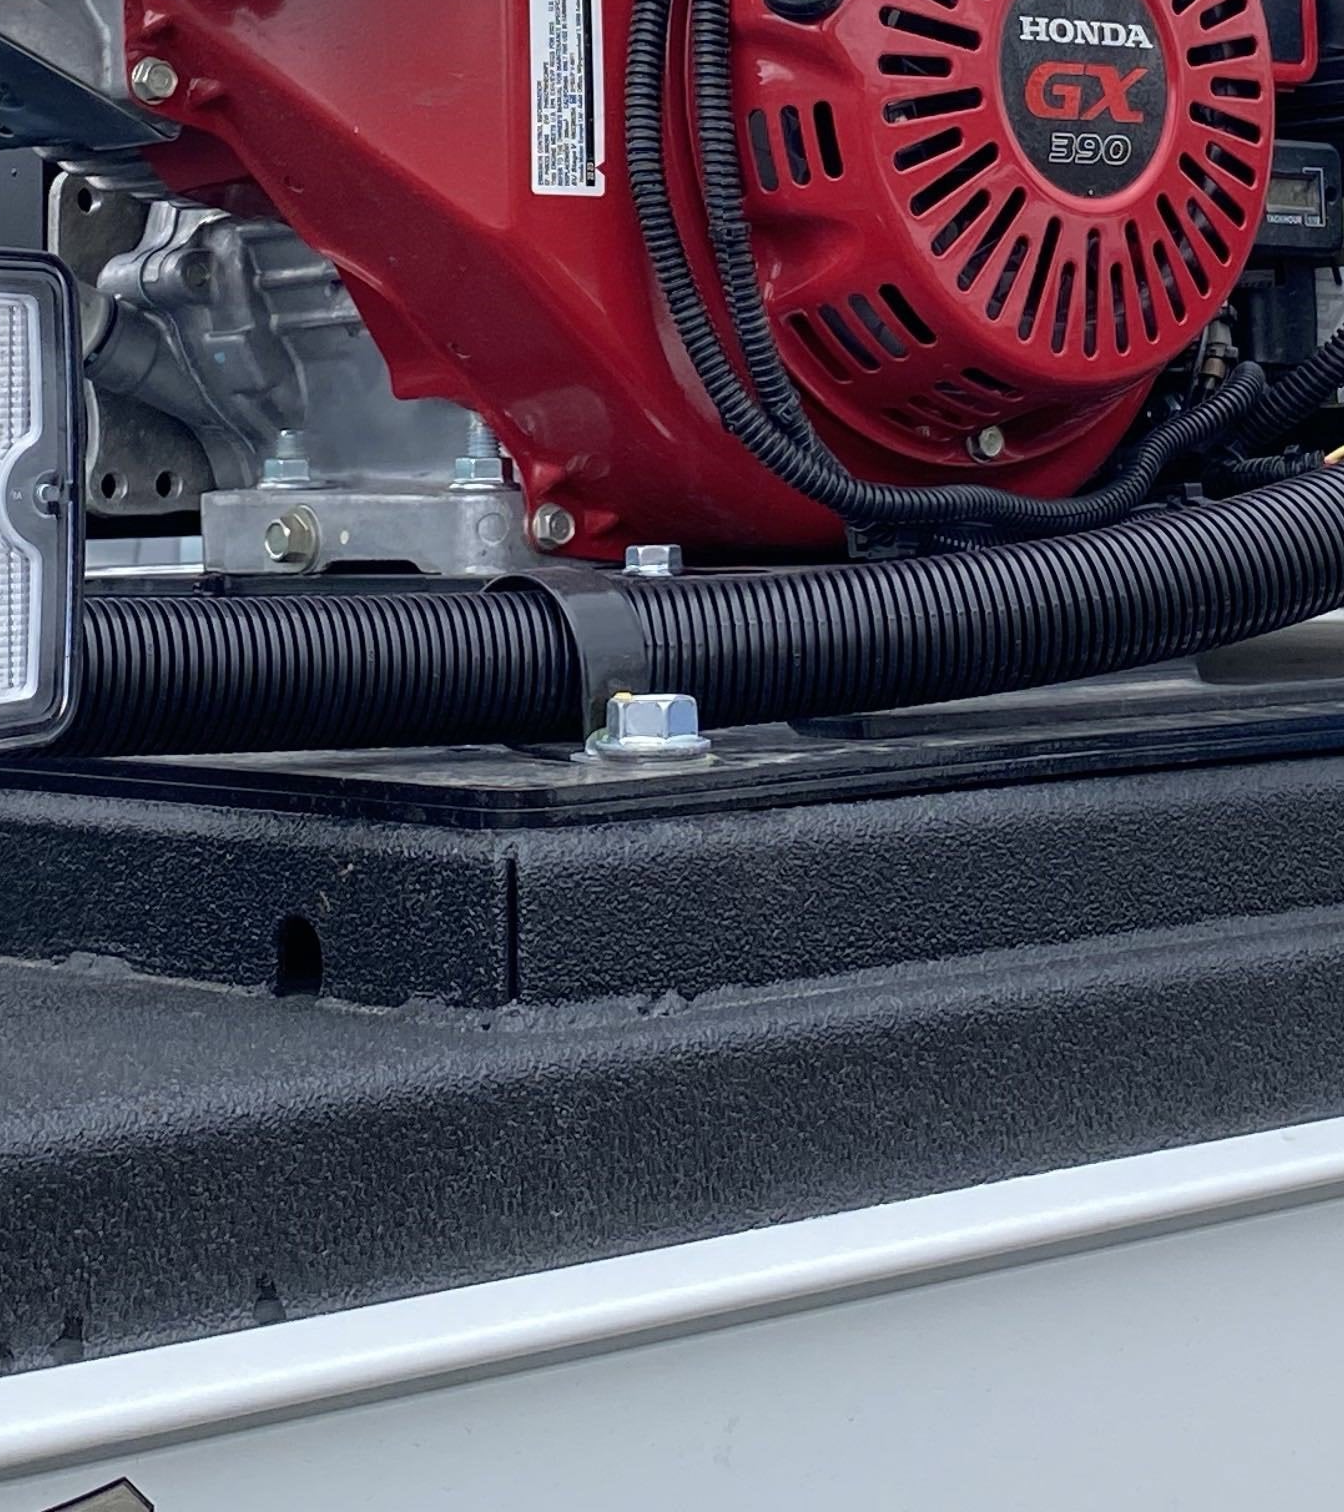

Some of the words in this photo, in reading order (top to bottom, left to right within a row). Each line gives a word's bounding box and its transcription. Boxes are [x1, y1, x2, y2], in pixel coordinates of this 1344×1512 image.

[1019, 16, 1153, 49] HONDA
[1025, 61, 1148, 123] GX
[1048, 132, 1131, 166] 390
